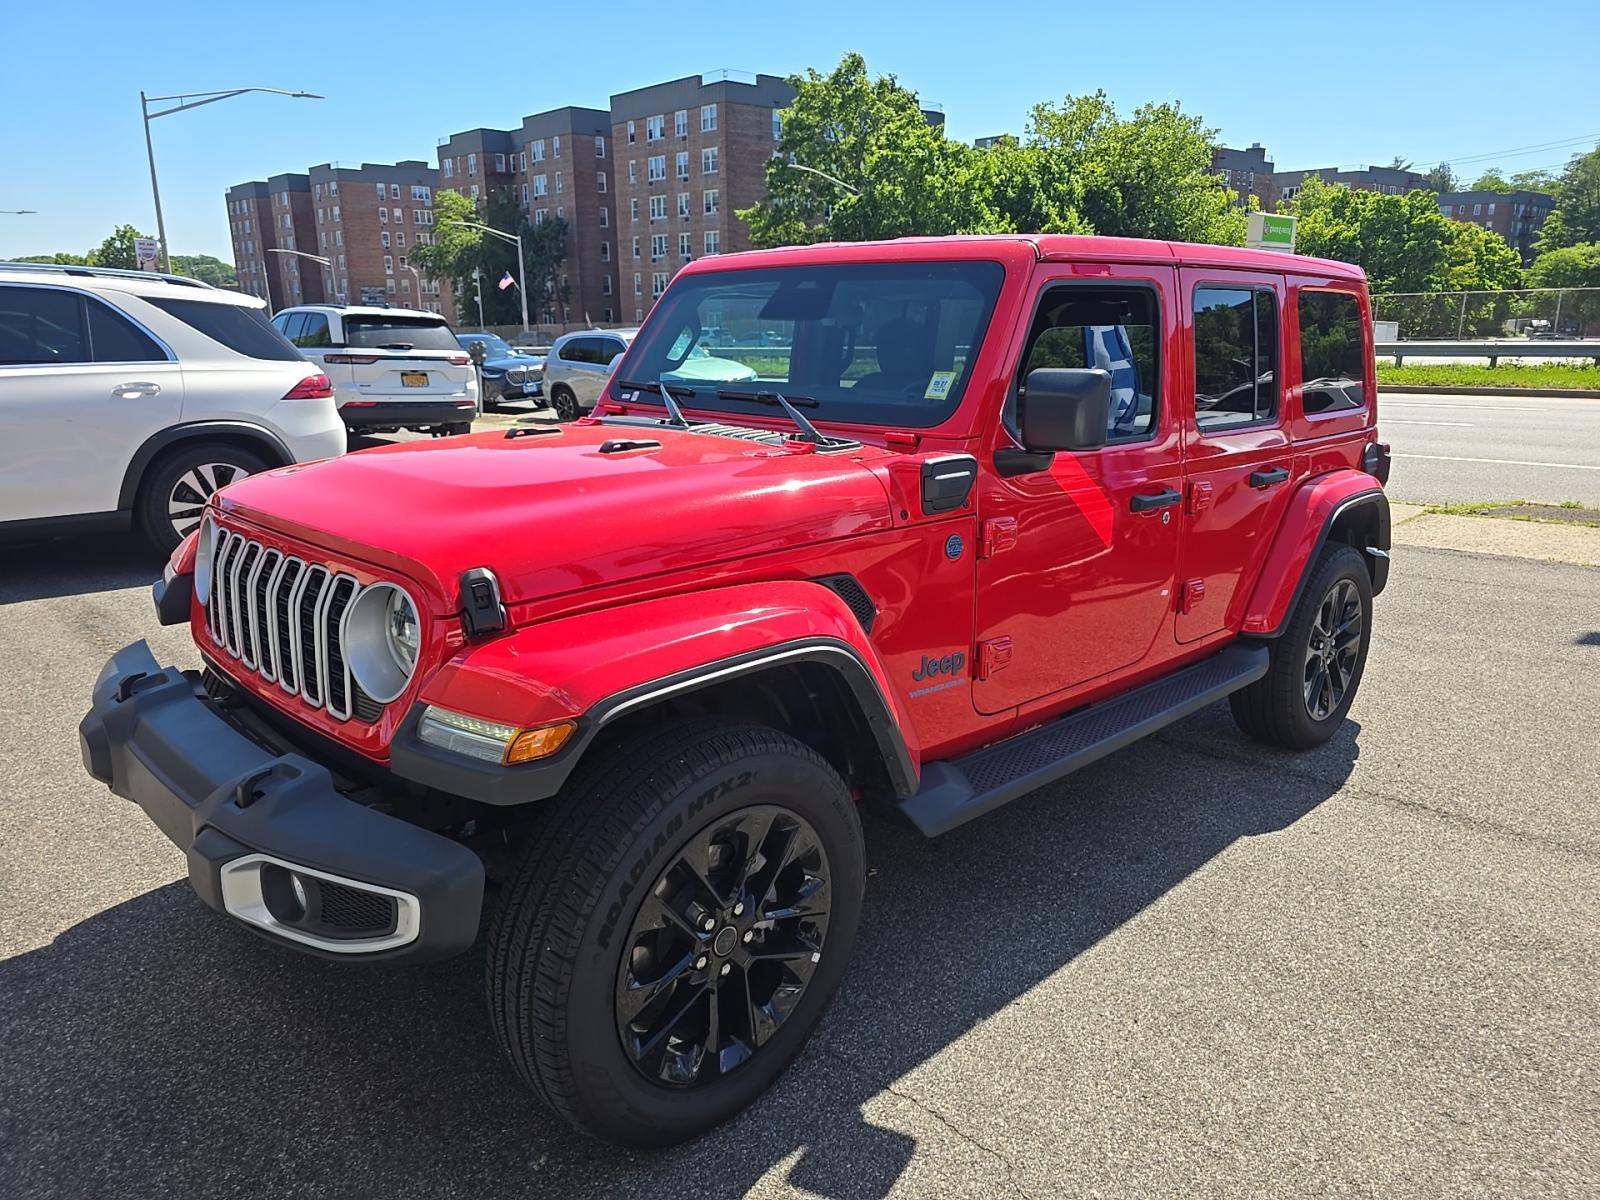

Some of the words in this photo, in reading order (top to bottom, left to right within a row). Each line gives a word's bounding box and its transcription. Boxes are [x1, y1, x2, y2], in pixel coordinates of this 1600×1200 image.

[911, 651, 965, 682] Jeep
[597, 813, 683, 949] ROADIAN
[687, 770, 752, 819] HTX2
